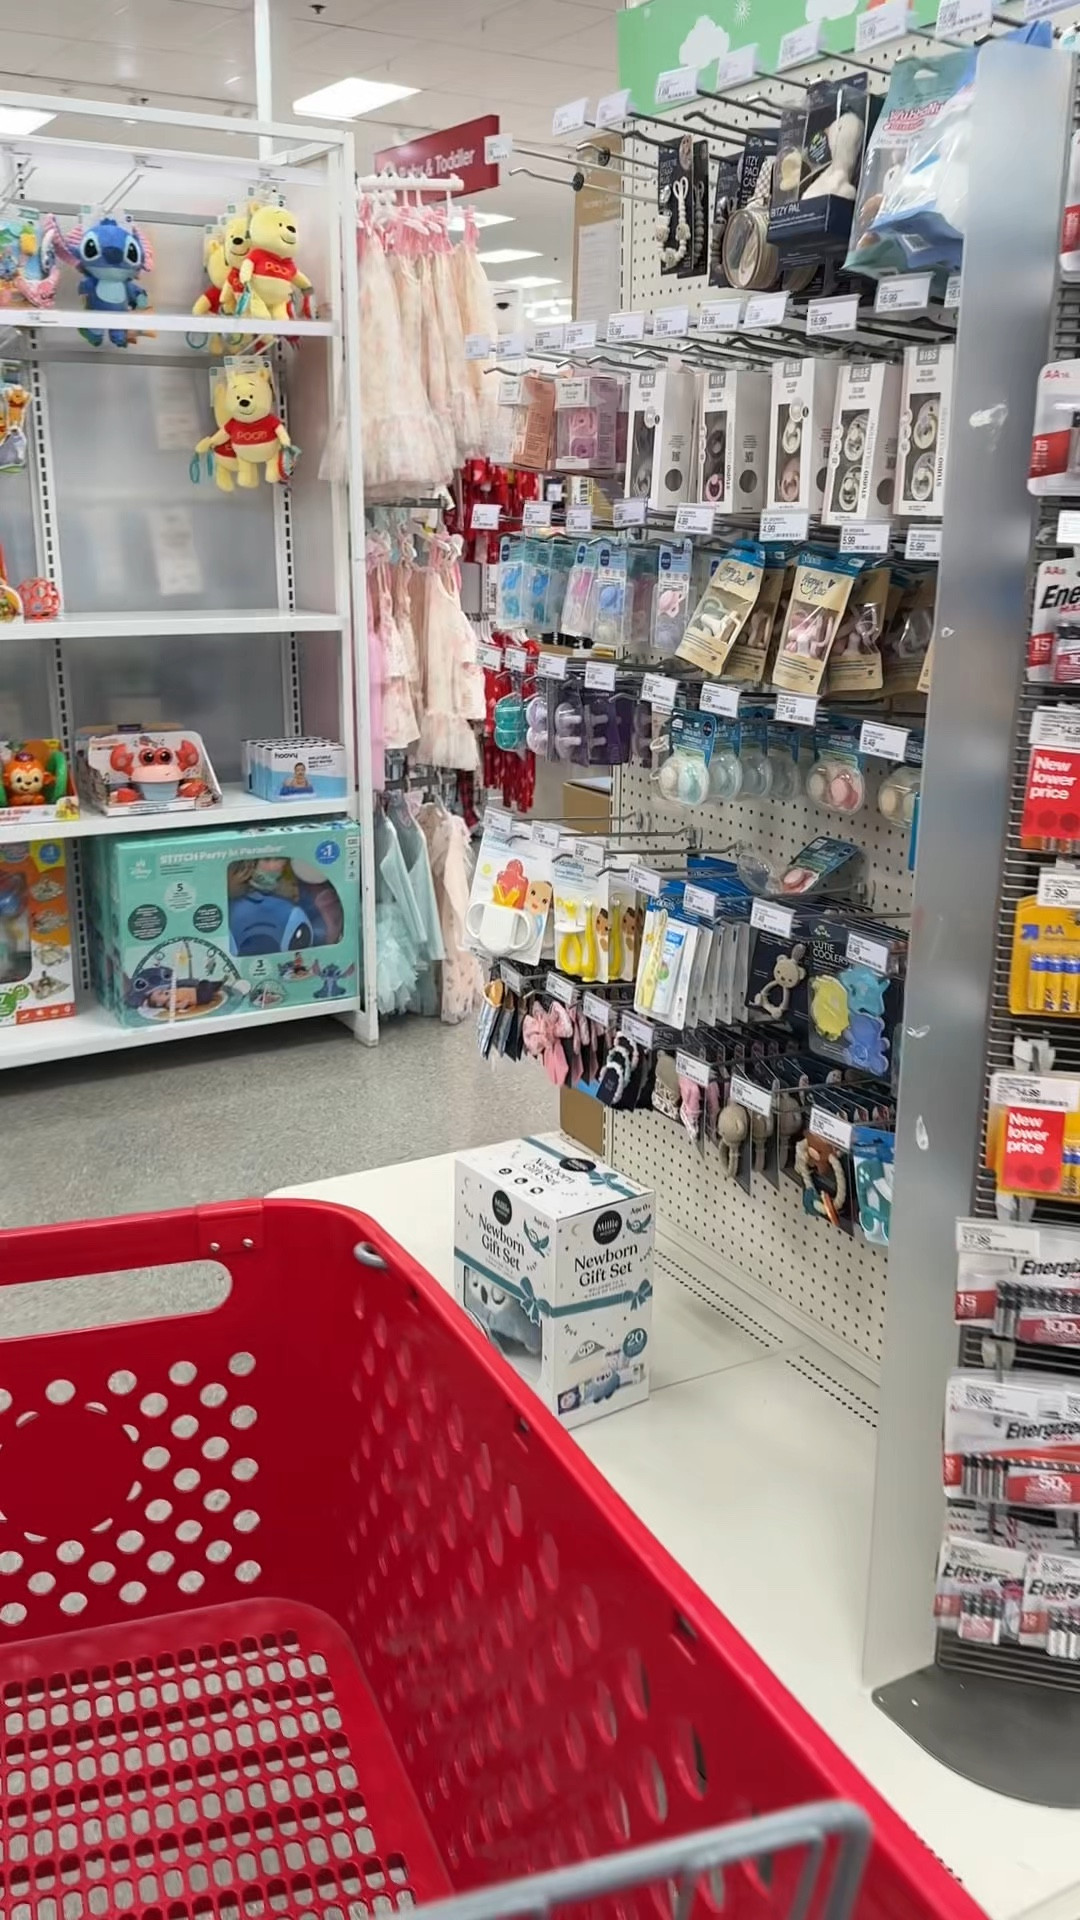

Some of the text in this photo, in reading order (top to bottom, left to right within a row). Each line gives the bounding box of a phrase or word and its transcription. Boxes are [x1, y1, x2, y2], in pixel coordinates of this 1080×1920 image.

[425, 158, 434, 177] &
[434, 147, 476, 174] Toddler
[918, 350, 938, 361] BIBS
[851, 367, 870, 379] BIBS
[936, 457, 945, 487] STUDIO
[763, 524, 776, 534] 4.99
[842, 535, 856, 545] 5.99
[1033, 638, 1050, 651] 15
[1034, 756, 1072, 772] New
[1032, 770, 1078, 787] lower
[1029, 784, 1070, 800] price
[160, 851, 199, 865] STITCH
[200, 850, 227, 862] Party
[176, 883, 184, 892] 5
[1044, 925, 1065, 935] AA
[812, 940, 835, 952] CUTIE
[812, 949, 849, 967] COOLERS
[1008, 1112, 1044, 1128] New
[1007, 1125, 1050, 1142] lower
[1006, 1139, 1045, 1155] price
[596, 1219, 620, 1233] Millie
[479, 1213, 525, 1257] Newborn
[481, 1233, 521, 1272] Gift Set
[574, 1244, 638, 1273] Newborn
[579, 1268, 606, 1288] Gift
[609, 1261, 632, 1279] Set
[627, 1330, 644, 1346] 20
